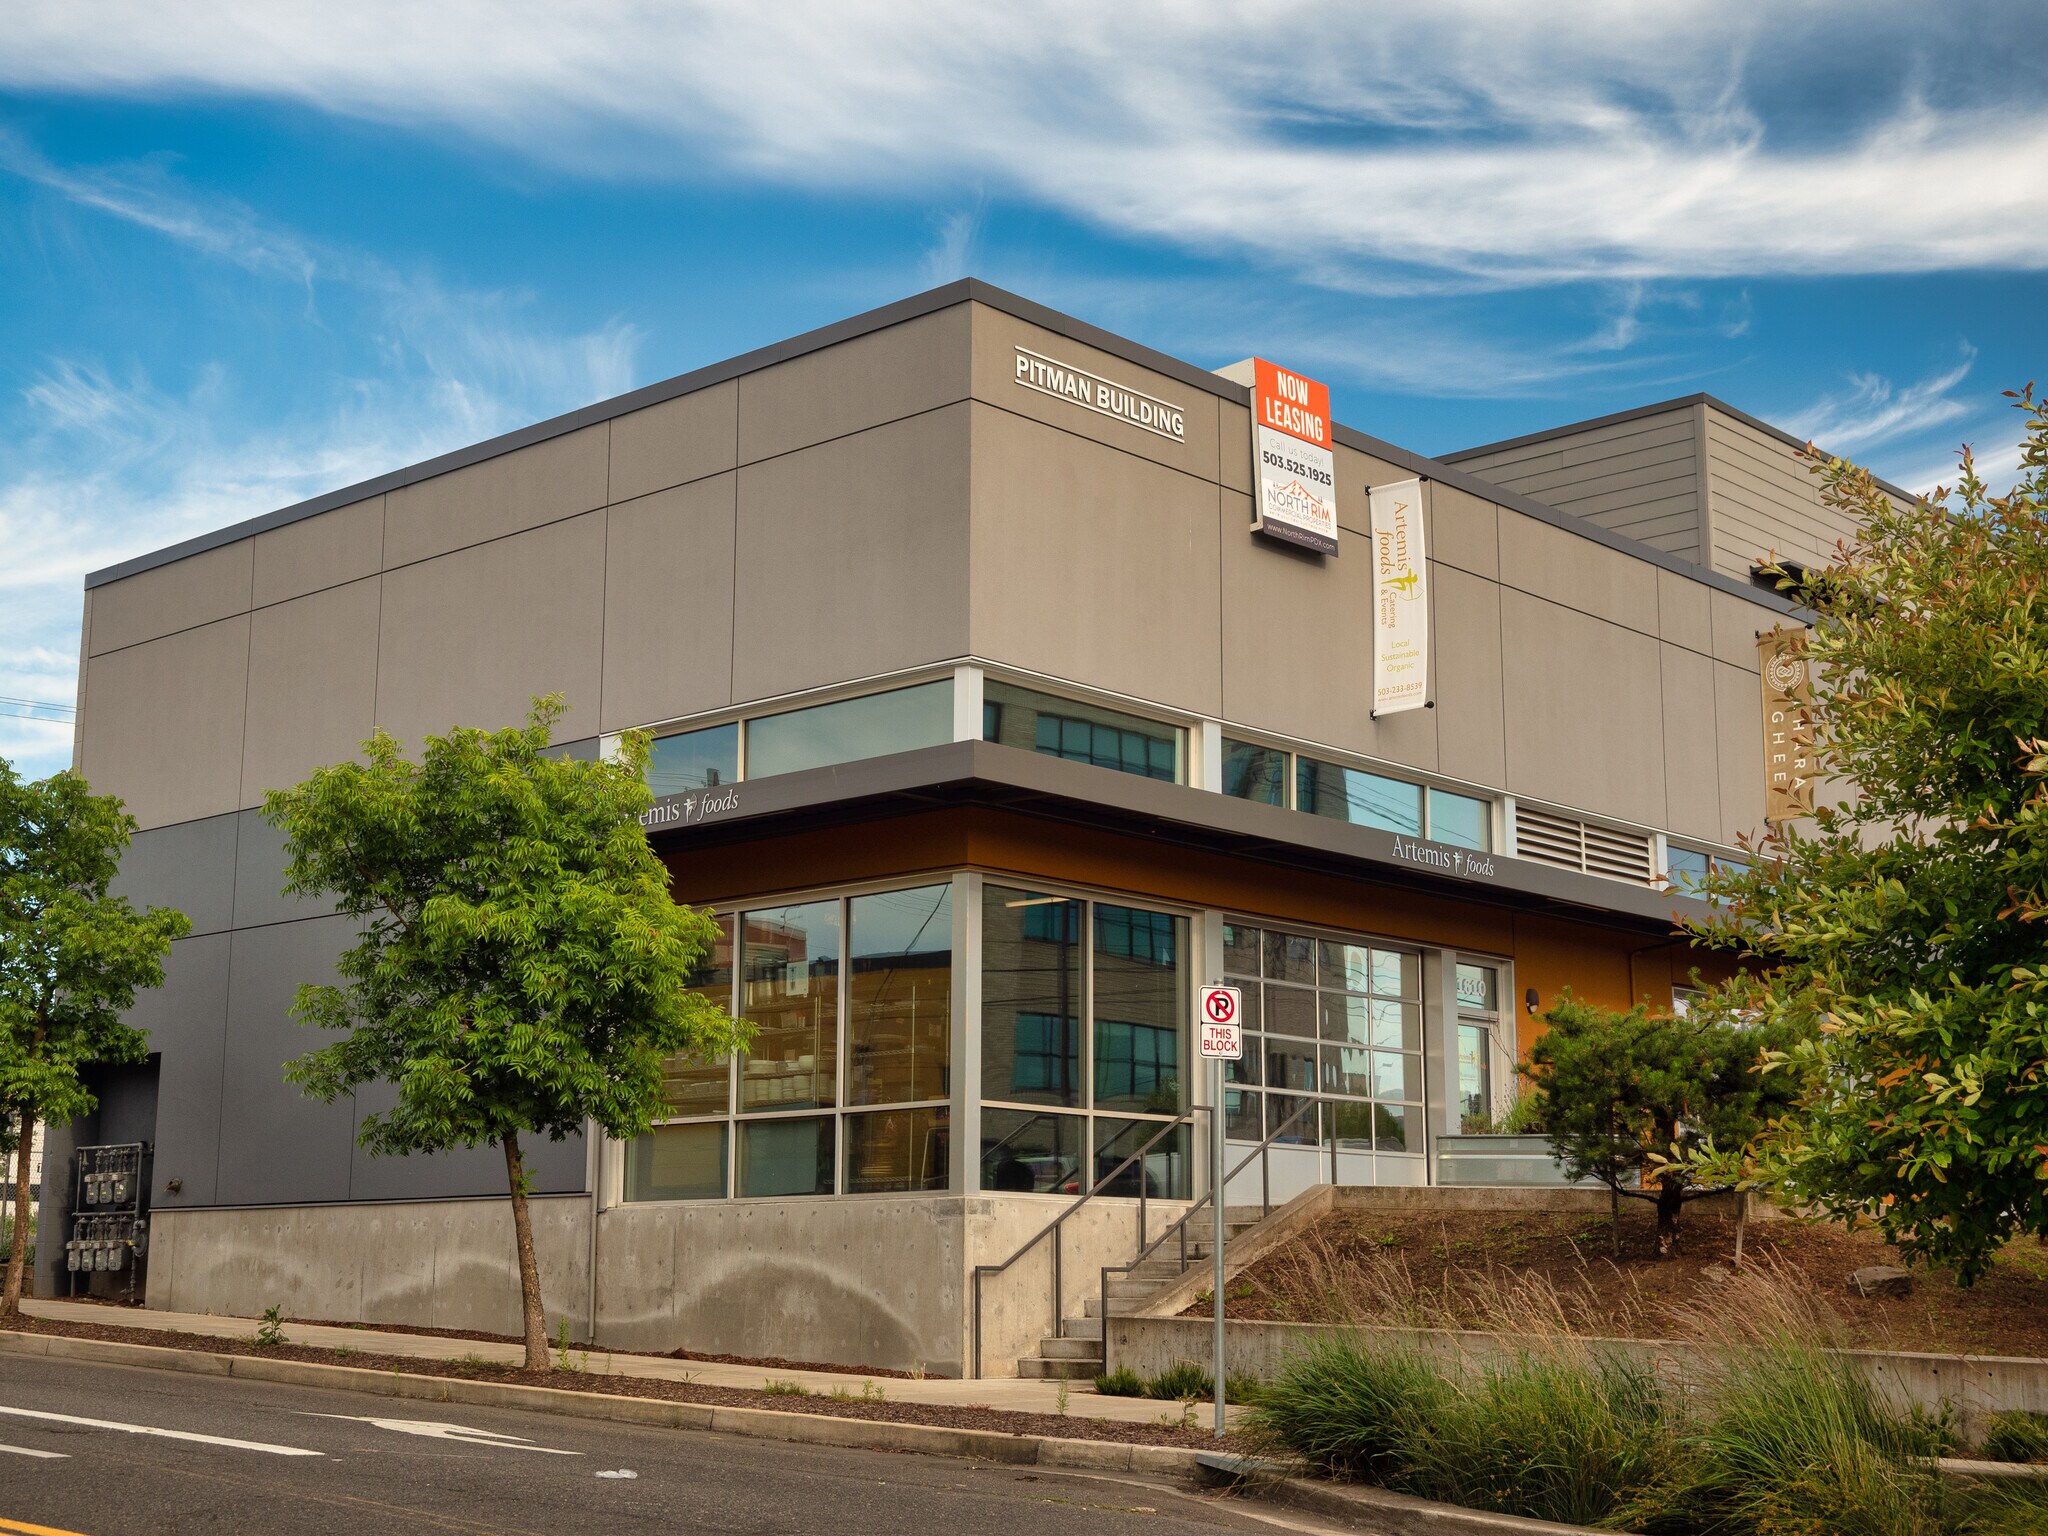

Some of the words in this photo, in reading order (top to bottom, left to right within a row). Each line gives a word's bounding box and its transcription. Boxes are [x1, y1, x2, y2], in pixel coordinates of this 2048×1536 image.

[1016, 354, 1091, 403] PITMAN
[1096, 384, 1184, 437] BUILDING
[1277, 371, 1308, 406] NOW
[1266, 396, 1323, 442] LEASING
[1263, 450, 1332, 486] 503.525.1925
[1269, 438, 1286, 452] Call
[1288, 448, 1298, 457] us
[1300, 450, 1324, 467] today!
[1375, 527, 1396, 575] foods
[1394, 501, 1411, 572] Artemis
[1381, 598, 1389, 625] Events
[1388, 591, 1398, 629] Catering
[1381, 649, 1420, 662] Sustainable
[1391, 639, 1410, 649] Local
[1386, 662, 1415, 673] Organic
[1377, 681, 1423, 696] 503-233-8539
[1771, 711, 1787, 782] GHEE
[696, 789, 739, 822] foods
[1392, 835, 1451, 868] Artemis
[1463, 854, 1494, 877] foods
[1203, 1039, 1238, 1052] BLOCK
[1209, 1027, 1232, 1040] THIS
